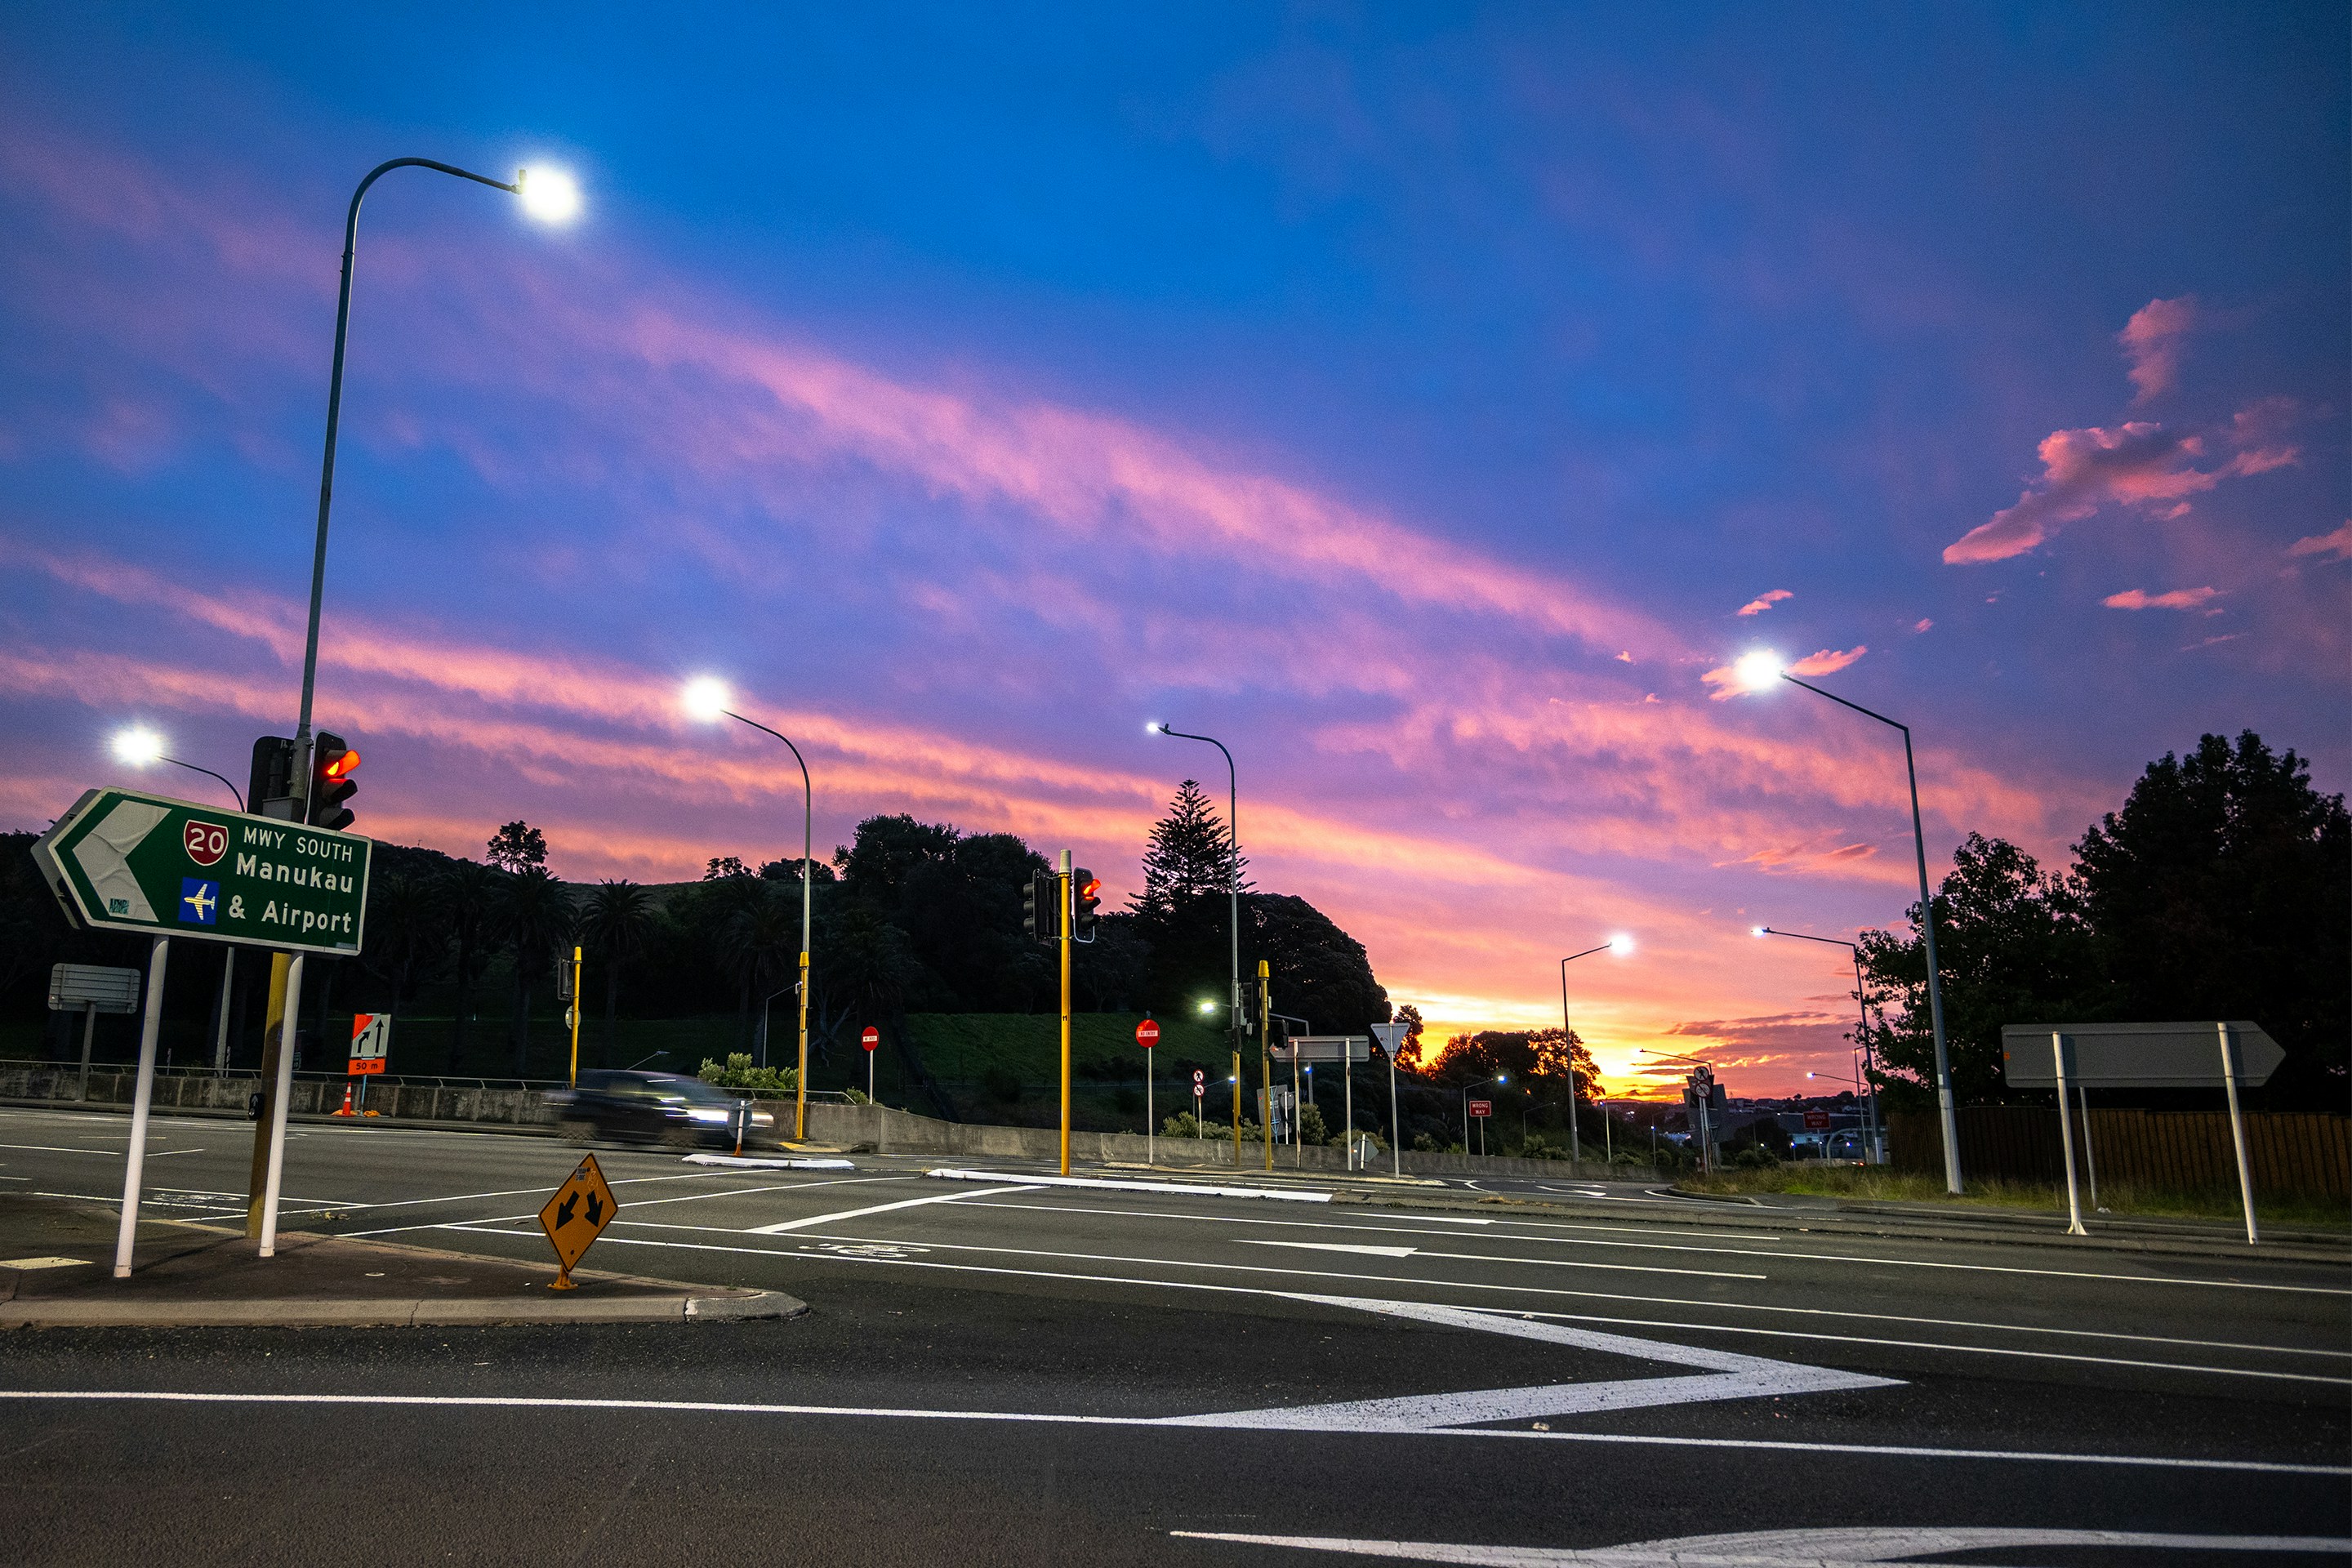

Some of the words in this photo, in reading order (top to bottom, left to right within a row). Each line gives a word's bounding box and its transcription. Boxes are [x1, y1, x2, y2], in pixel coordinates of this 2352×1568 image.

[189, 827, 225, 854] 20
[243, 826, 286, 849] MWY
[296, 836, 353, 862] SOUTH
[236, 852, 354, 893] Manukau
[229, 894, 246, 920] &
[261, 900, 352, 933] Airport
